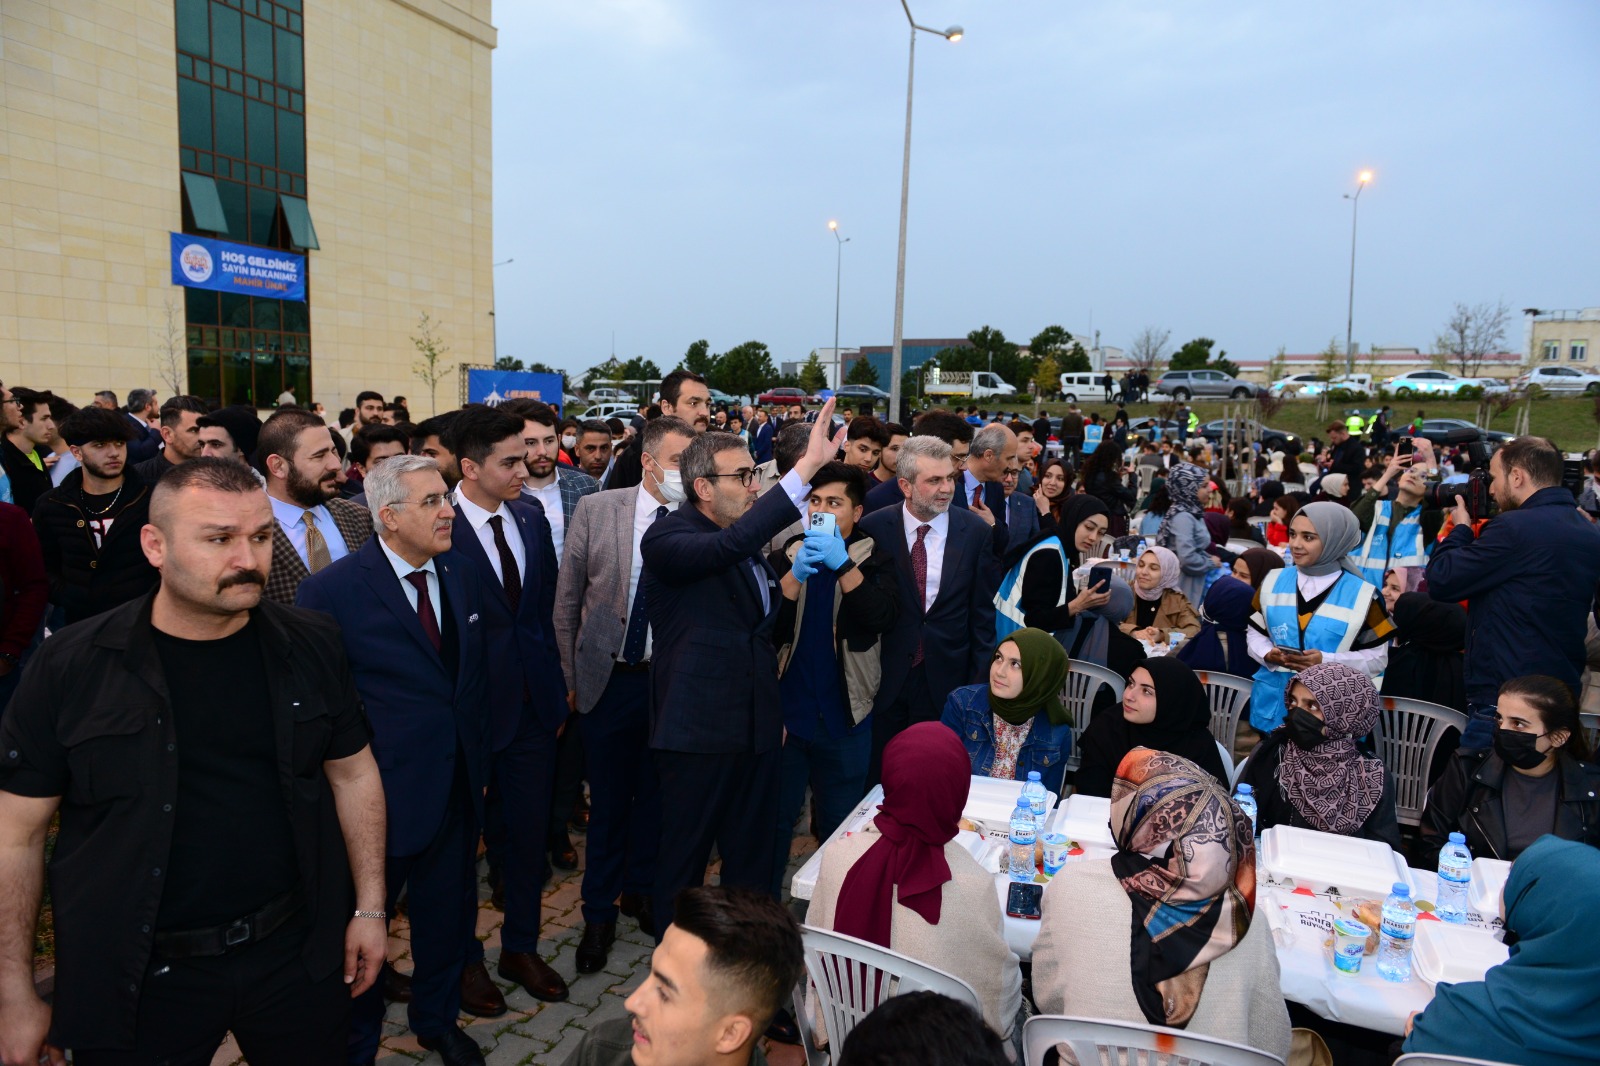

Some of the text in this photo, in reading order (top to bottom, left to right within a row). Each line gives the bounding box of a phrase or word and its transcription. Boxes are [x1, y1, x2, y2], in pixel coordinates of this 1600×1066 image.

[221, 251, 246, 265] HOŞ
[247, 256, 297, 272] GELDİNİZ
[222, 263, 298, 282] SAYIN BAKANIMIZ
